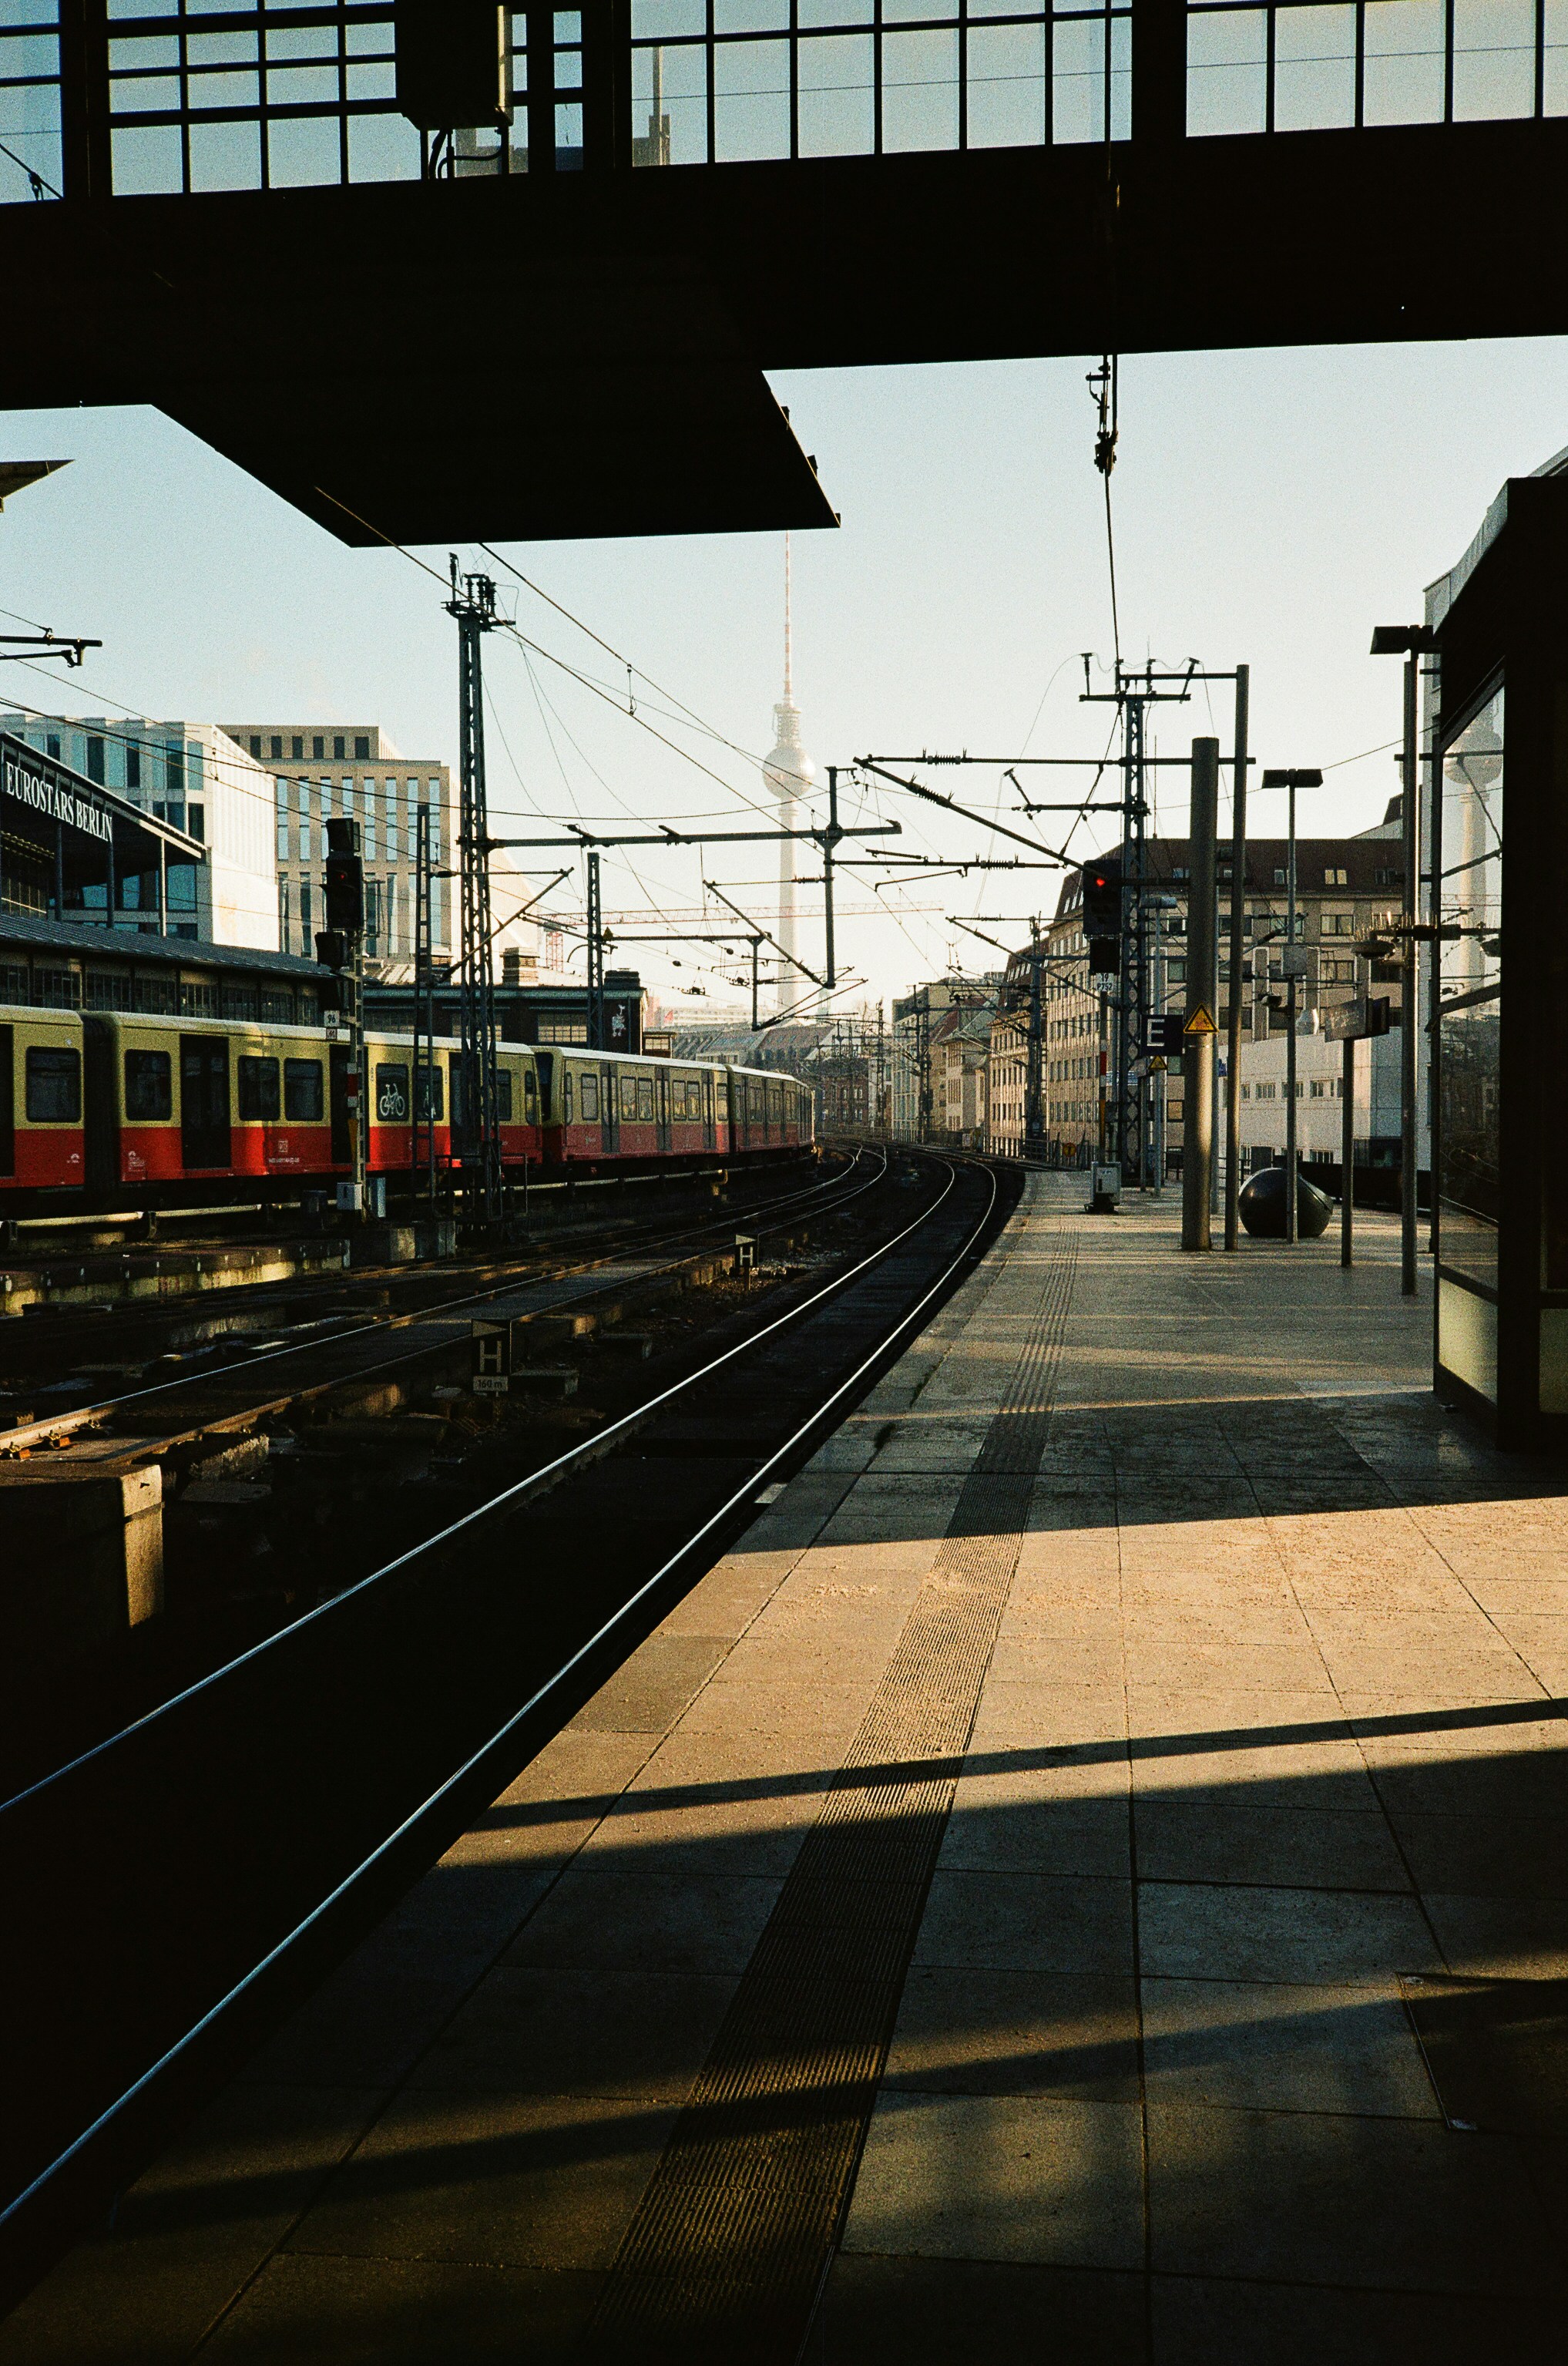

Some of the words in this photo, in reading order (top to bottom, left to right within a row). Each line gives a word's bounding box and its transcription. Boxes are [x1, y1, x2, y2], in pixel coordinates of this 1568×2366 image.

[6, 761, 74, 825] EUROSTARS
[76, 798, 112, 842] BERLIN
[1102, 973, 1109, 982] 19
[327, 1014, 336, 1023] 96
[1147, 1019, 1165, 1047] E
[740, 1246, 753, 1265] H
[479, 1339, 502, 1373] H
[478, 1380, 492, 1388] 160
